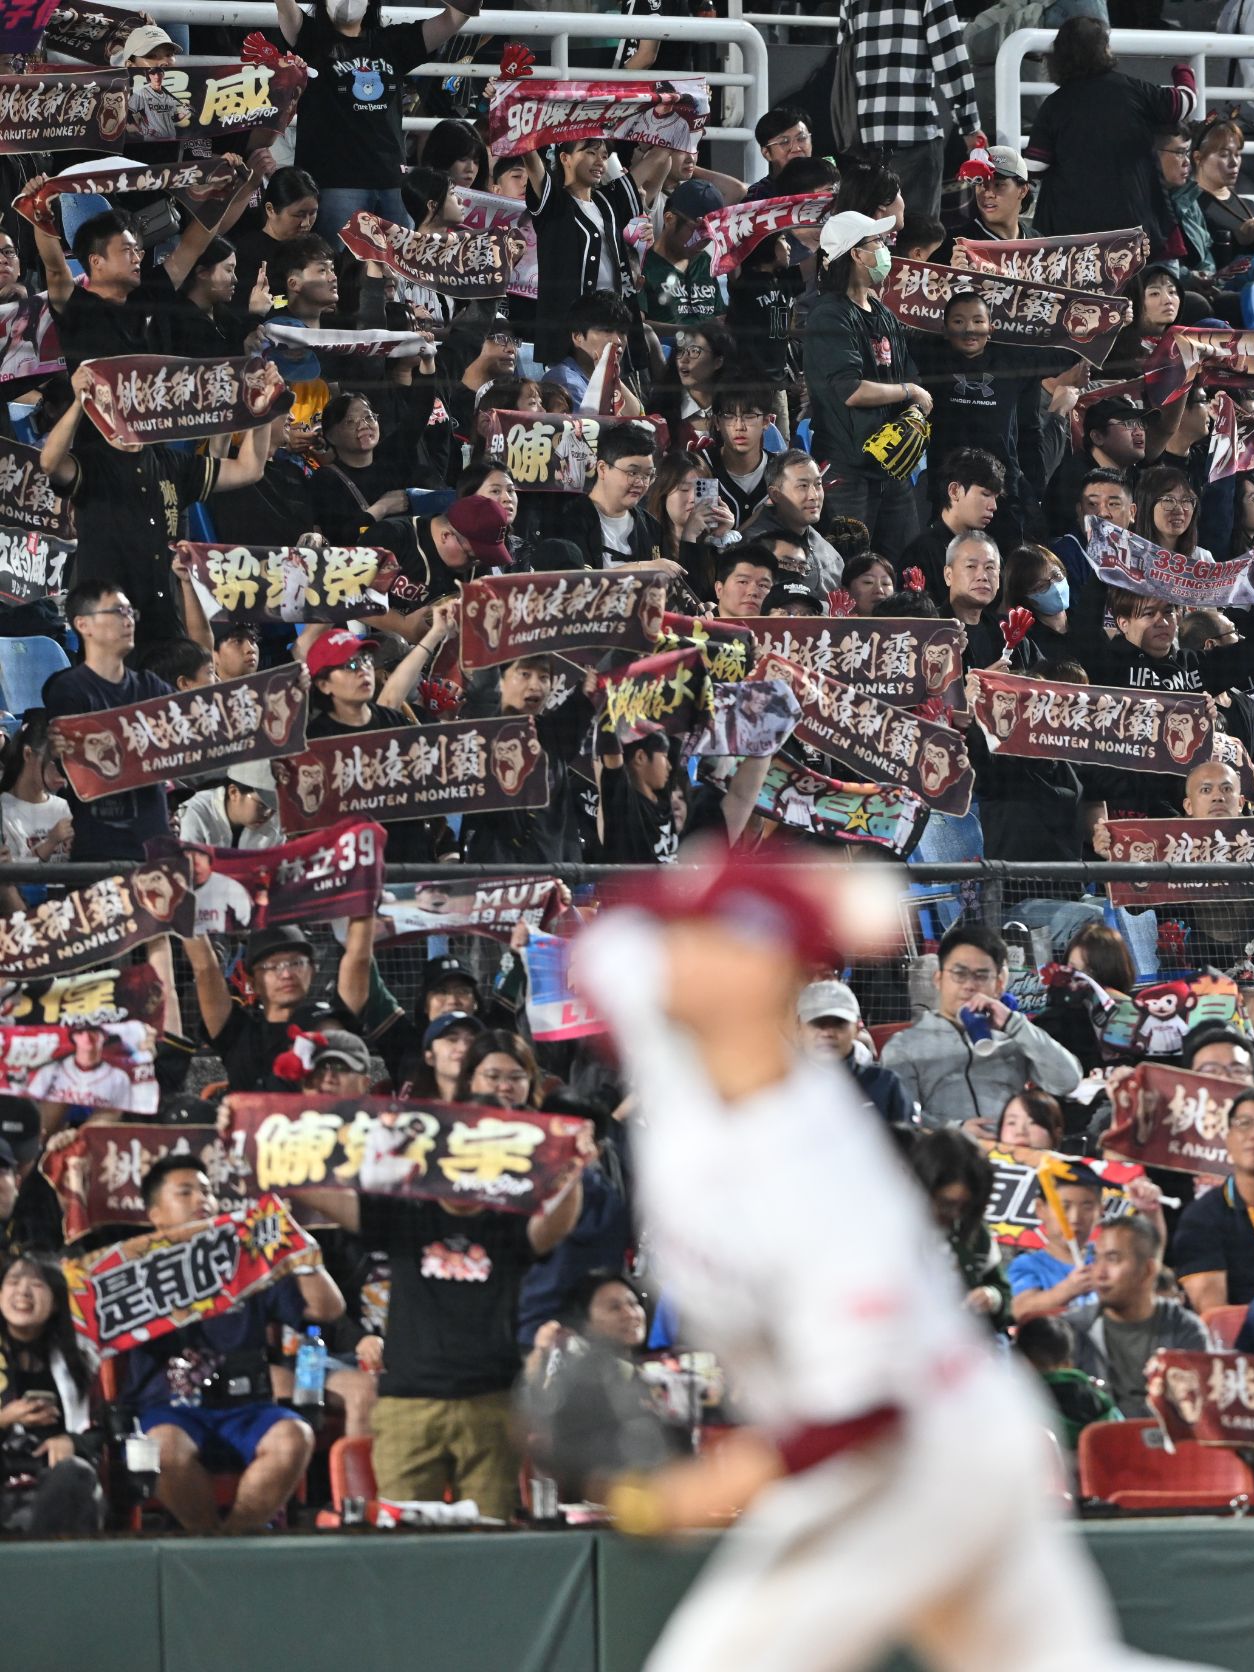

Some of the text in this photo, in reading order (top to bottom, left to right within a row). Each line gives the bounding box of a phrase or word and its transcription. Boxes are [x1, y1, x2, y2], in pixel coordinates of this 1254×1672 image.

[333, 56, 394, 77] MONKEYS
[222, 106, 279, 128] NONSTOP
[353, 102, 388, 112] Care Bears
[42, 125, 86, 138] MONKEYS
[386, 223, 500, 273] 桃猿制霸
[438, 272, 503, 287] MONKEYS
[989, 317, 1052, 338] ONKEYS
[117, 361, 240, 414] 桃猿制霸
[950, 397, 997, 407] UNDER ARMOUR
[127, 409, 234, 433] RAKUTEN MONKEYS
[508, 575, 641, 625] 桃猿制霸
[783, 583, 812, 594] Rakuten
[507, 621, 627, 646] RAKUTEN MONKEYS
[849, 680, 915, 695] ONKEYS
[118, 684, 264, 756] 桃猿制霸
[799, 670, 922, 768] 桃猿制霸
[1023, 690, 1164, 743] 桃猿制霸
[142, 738, 256, 772] RAKUTEN MONKEYS
[1029, 732, 1156, 759] RAKUTEN MONKEYS
[332, 729, 487, 798] 桃猿制霸
[854, 745, 910, 781] MONKEYS
[339, 782, 486, 813] RAKUTEN MONKEYS
[57, 919, 139, 961] MONKEYS
[93, 1221, 239, 1339] 是有的
